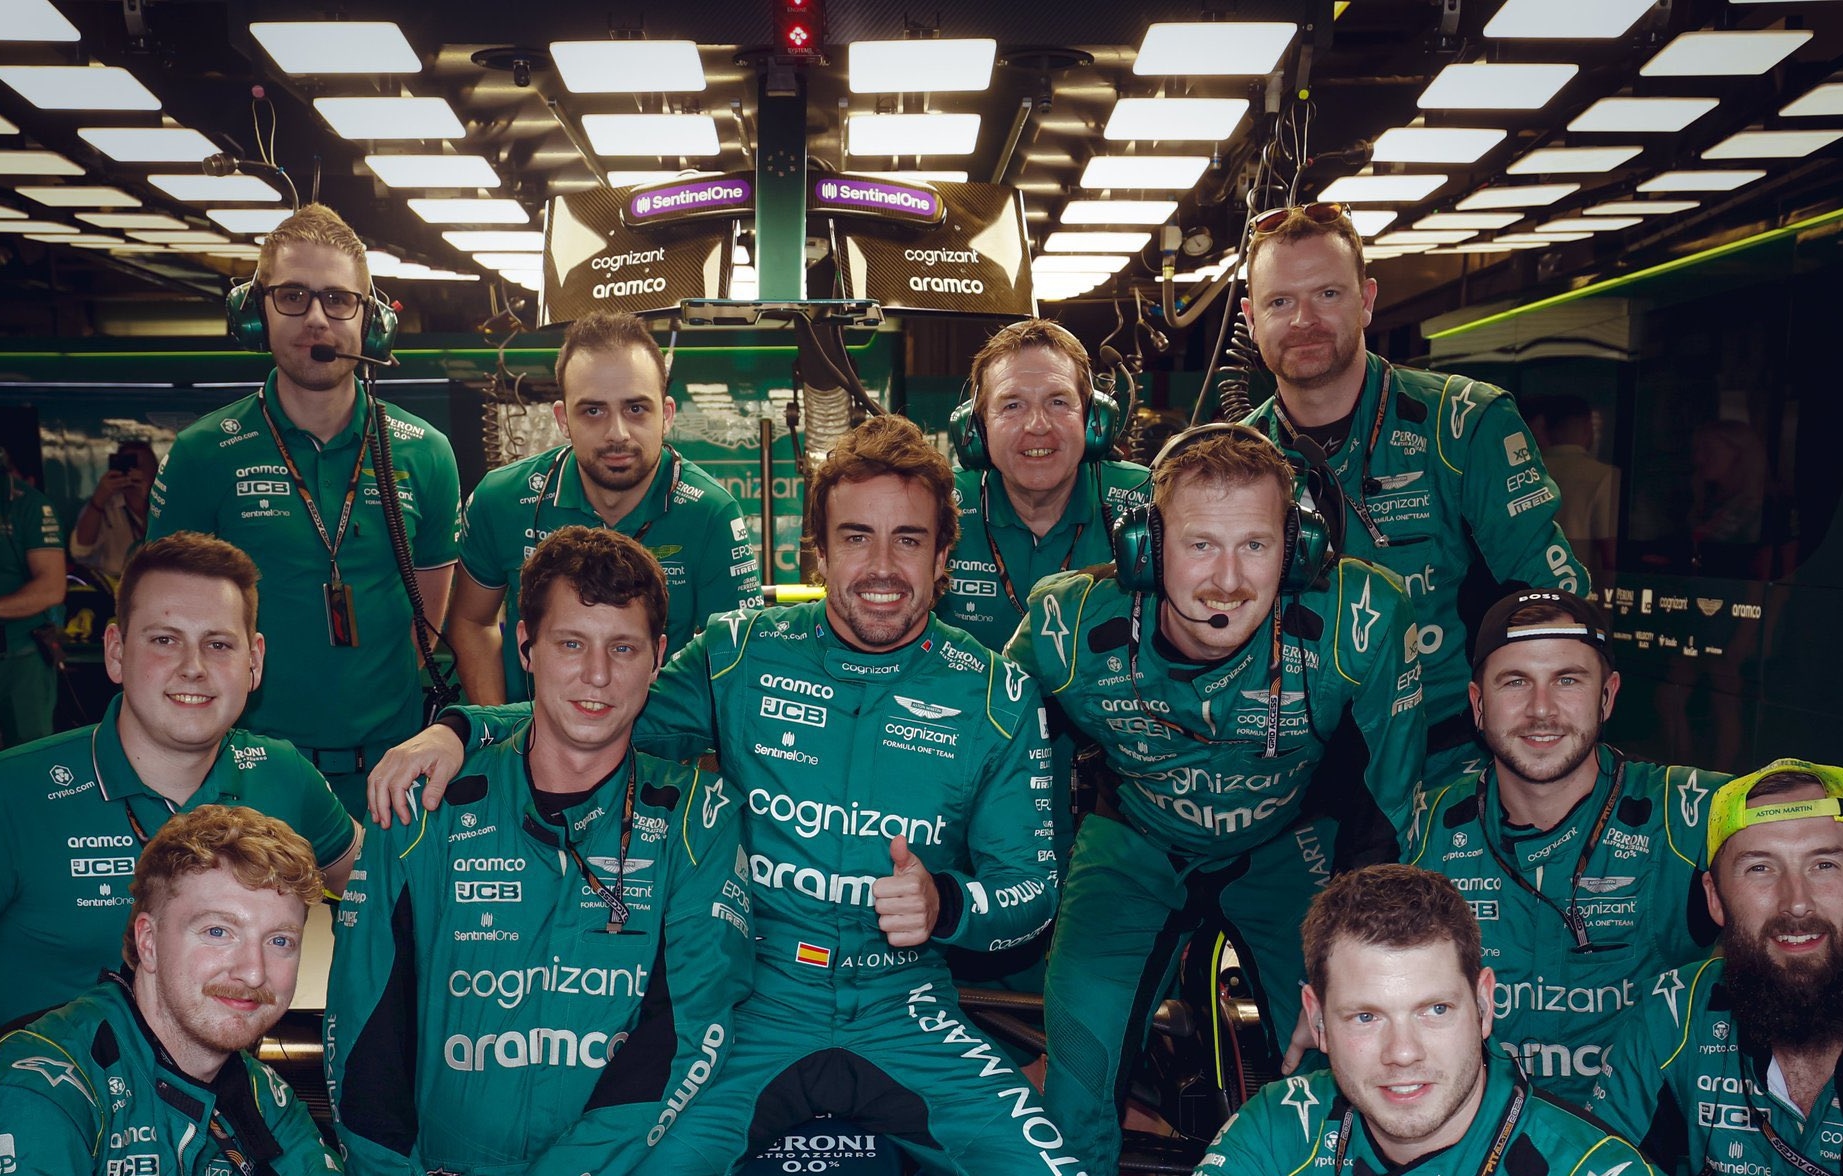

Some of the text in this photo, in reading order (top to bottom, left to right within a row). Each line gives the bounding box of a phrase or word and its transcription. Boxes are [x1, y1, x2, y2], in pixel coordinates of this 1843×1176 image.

[652, 185, 743, 209] SentinelOne
[840, 185, 930, 211] SentinelOne
[591, 247, 665, 272] cognizant
[904, 248, 979, 268] cognizant
[592, 277, 666, 299] aramco
[909, 276, 984, 295] aramco
[219, 430, 259, 448] crypto.com
[236, 465, 288, 477] aramco
[238, 482, 290, 495] JCB
[241, 509, 290, 518] SentinelOne
[1366, 494, 1430, 514] cognizant
[949, 559, 997, 573] aramco
[1518, 592, 1561, 603] BOSS
[1732, 604, 1762, 619] aramco
[941, 641, 986, 672] PERONI
[841, 662, 900, 675] cognizant
[1204, 655, 1254, 694] cognizant
[760, 673, 834, 700] aramco
[761, 697, 826, 727] JCB
[1268, 696, 1279, 750] GRID ACCESS
[885, 723, 959, 746] cognizant
[754, 743, 819, 766] SentinelOne
[882, 739, 915, 752] FORMULA
[936, 750, 955, 759] TEAM
[47, 780, 95, 800] crypto.com
[748, 788, 946, 846] cognizant
[1755, 804, 1813, 818] ASTON MARTIN
[68, 835, 133, 848] aramco
[1527, 827, 1577, 862] cognizant
[1607, 828, 1650, 848] PERONI
[1614, 849, 1637, 859] 0.0%
[72, 858, 135, 876] JCB
[454, 858, 525, 872] aramco
[749, 854, 879, 908] aram
[77, 897, 135, 907] SentinelOne
[456, 882, 521, 902] JCB
[454, 930, 518, 941] SentinelOne
[841, 950, 919, 968] ALONSO
[449, 956, 648, 1009] cognizant
[1494, 976, 1636, 1019] gnizant
[646, 1023, 725, 1147] aramco
[1510, 1096, 1524, 1123] 2023
[1771, 1138, 1806, 1166] ACCESS
[781, 1160, 840, 1174] 0.0%
